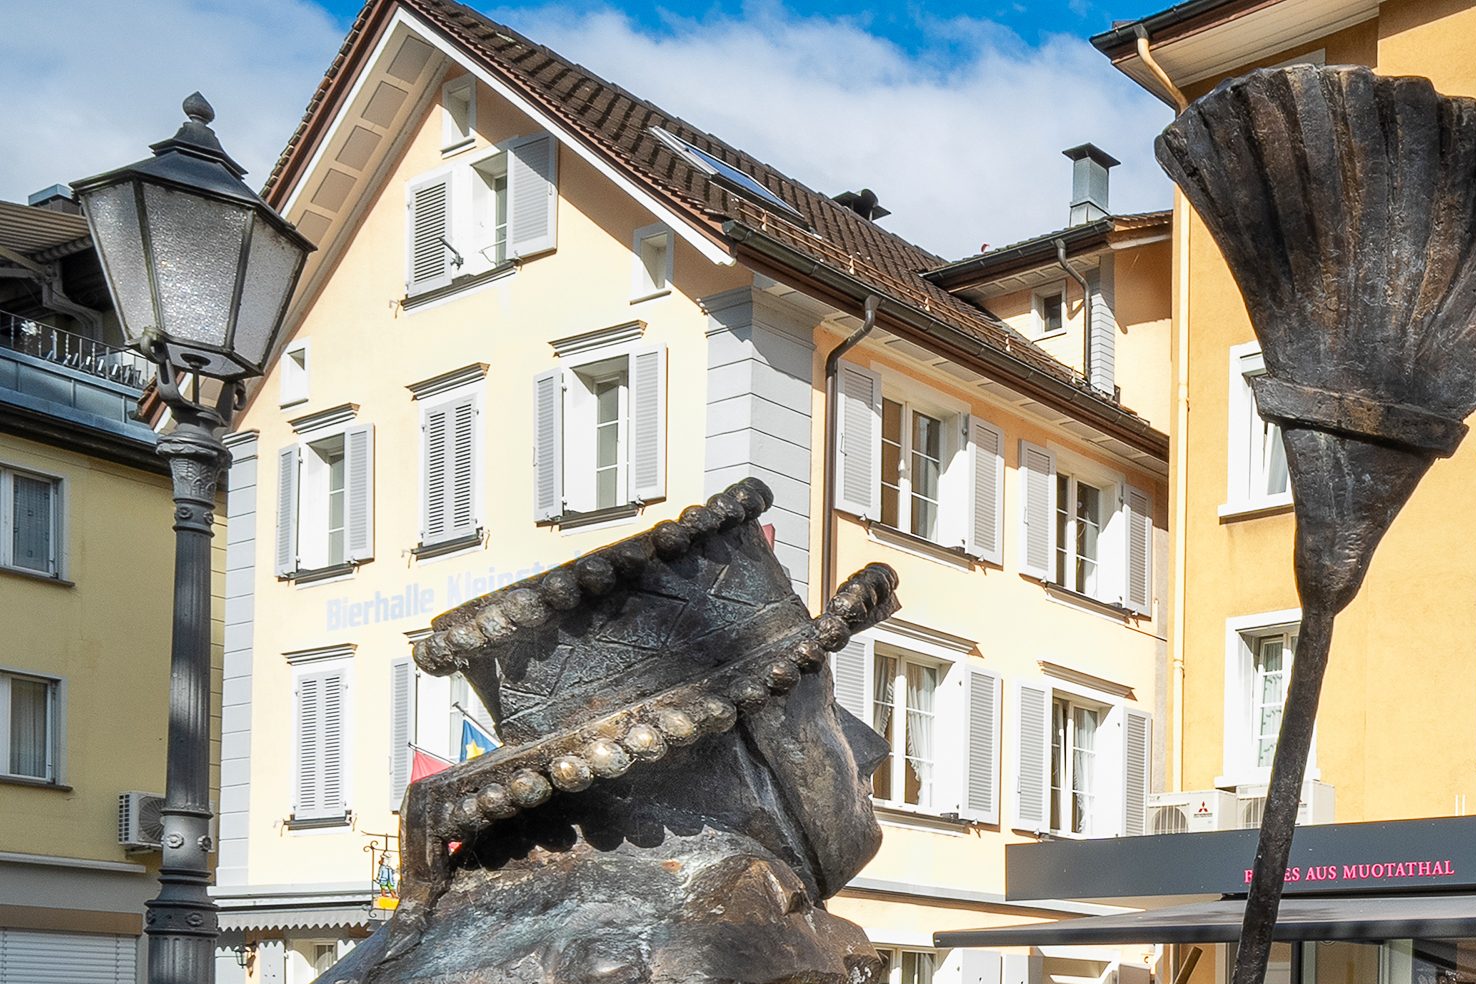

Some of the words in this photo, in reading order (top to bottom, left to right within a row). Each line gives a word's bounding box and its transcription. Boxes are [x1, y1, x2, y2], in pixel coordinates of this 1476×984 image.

[327, 583, 434, 632] Bierhalle
[447, 550, 582, 610] Kleinst
[1244, 867, 1301, 883] FES
[1305, 865, 1338, 881] AUS
[1343, 860, 1455, 880] MUOTATHAL
